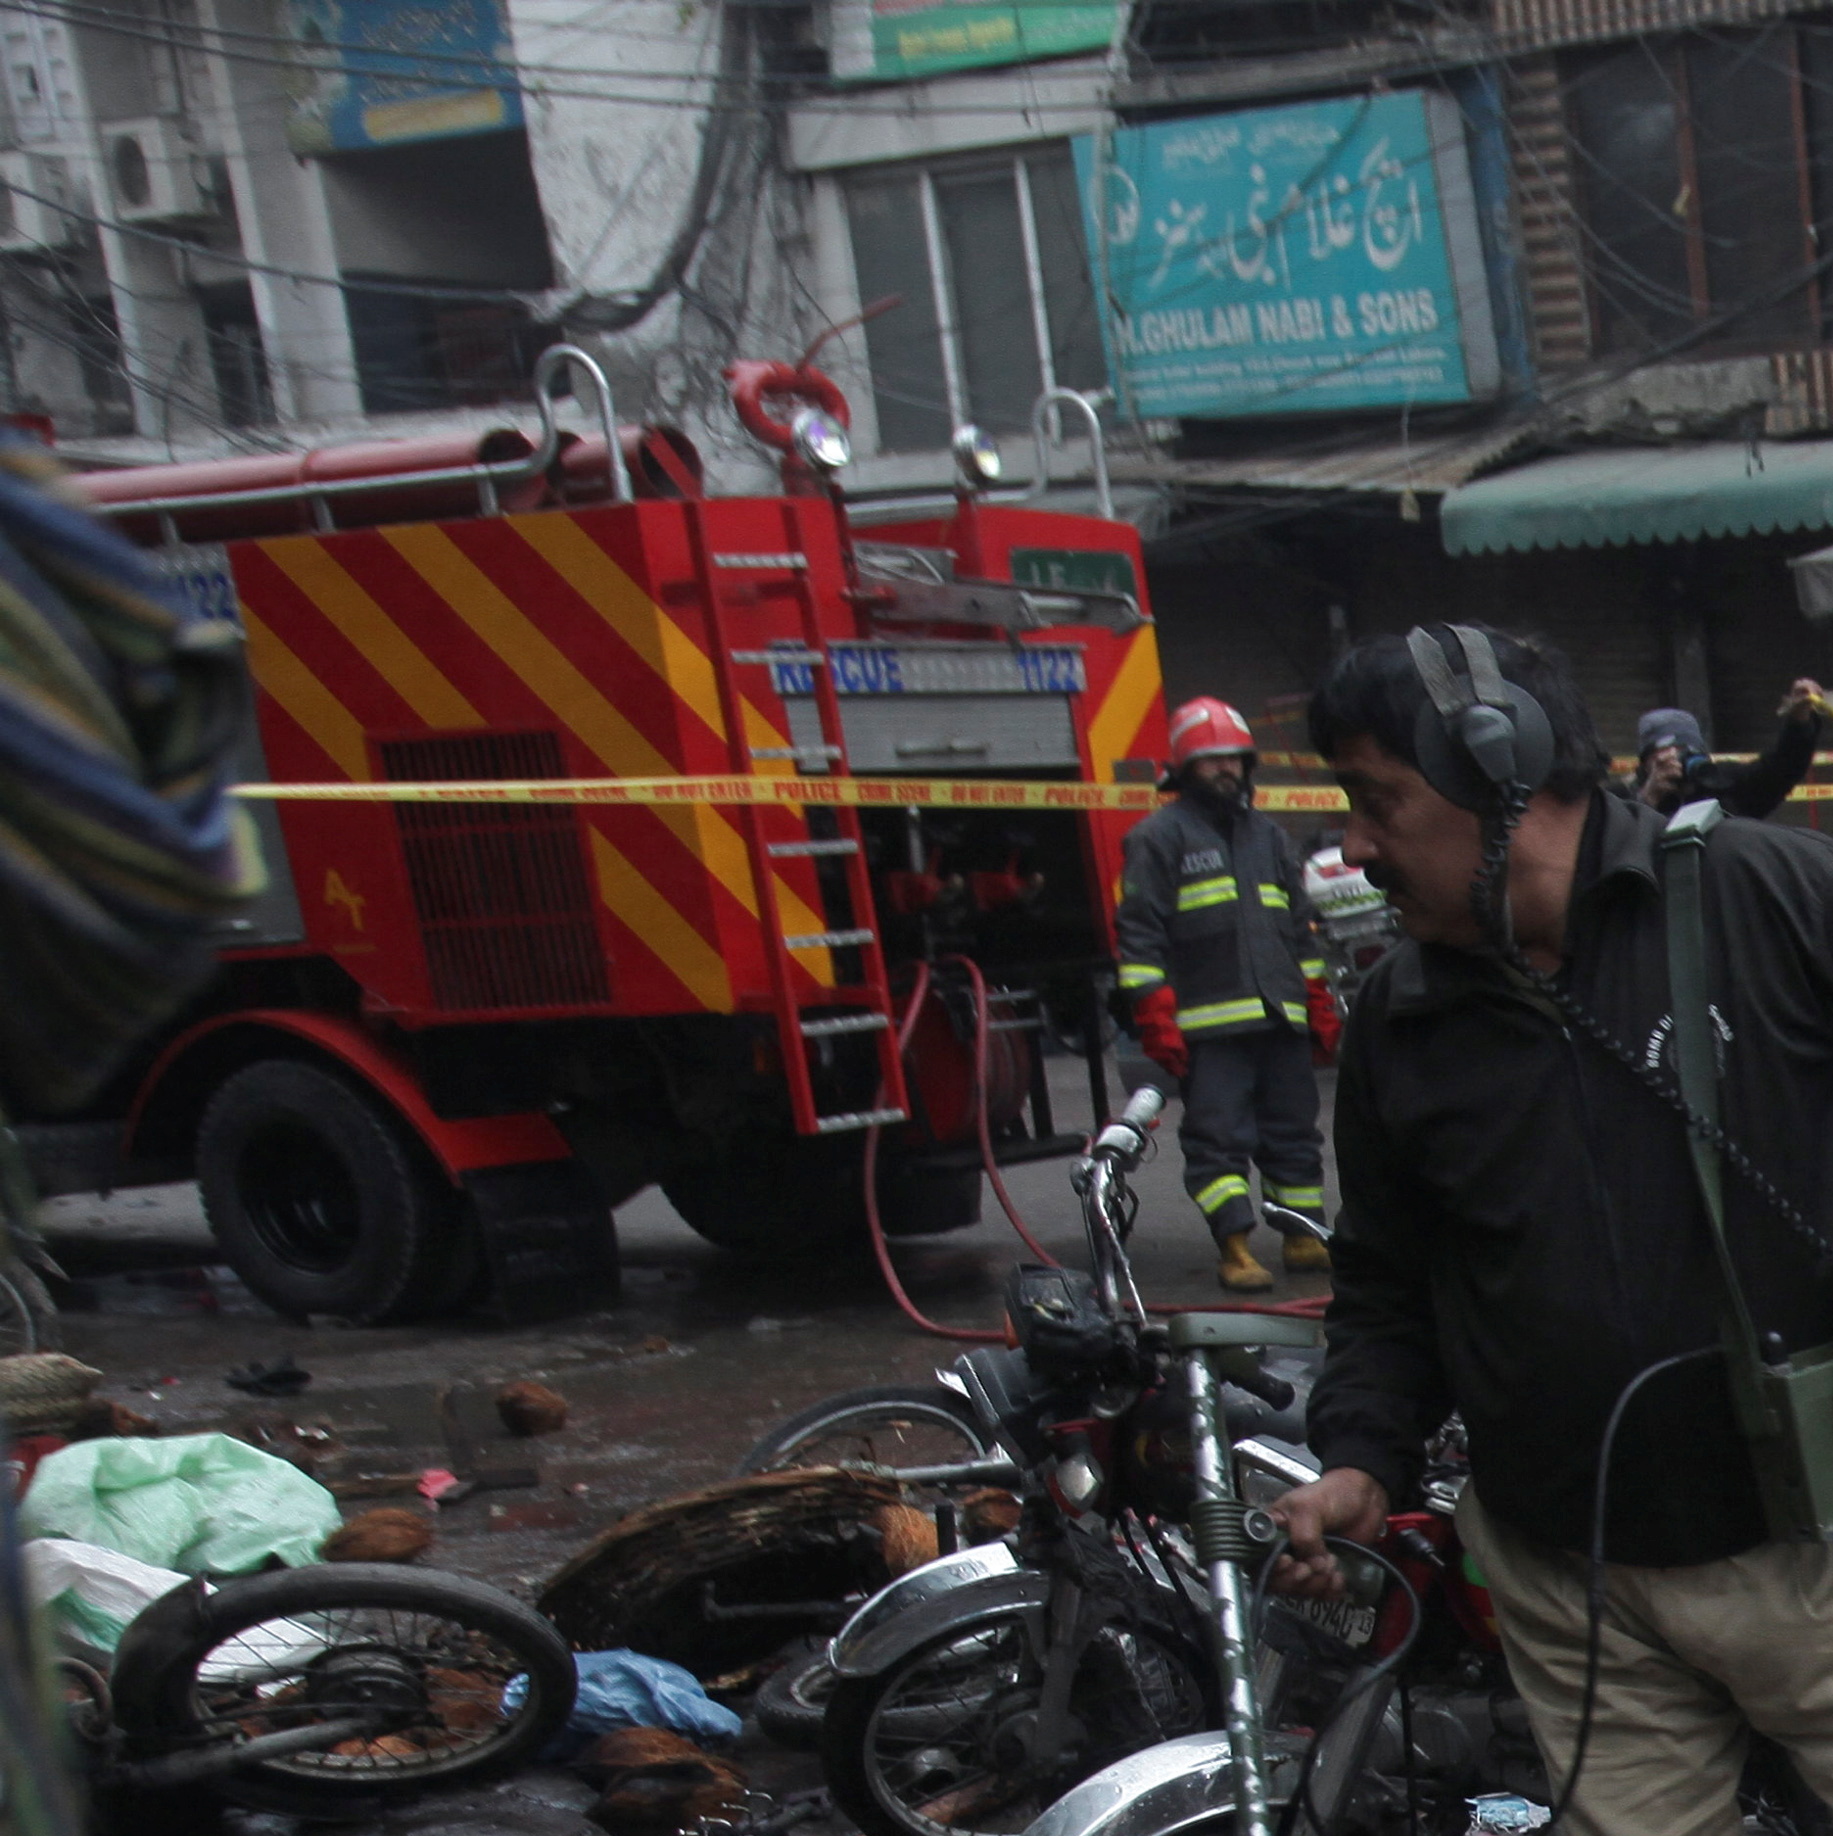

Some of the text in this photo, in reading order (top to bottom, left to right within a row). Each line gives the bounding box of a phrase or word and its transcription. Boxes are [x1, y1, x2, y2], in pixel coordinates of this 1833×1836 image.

[1256, 297, 1326, 343] NABI
[1331, 295, 1355, 339] &
[1357, 288, 1439, 337] SONS
[1015, 649, 1079, 692] 1122
